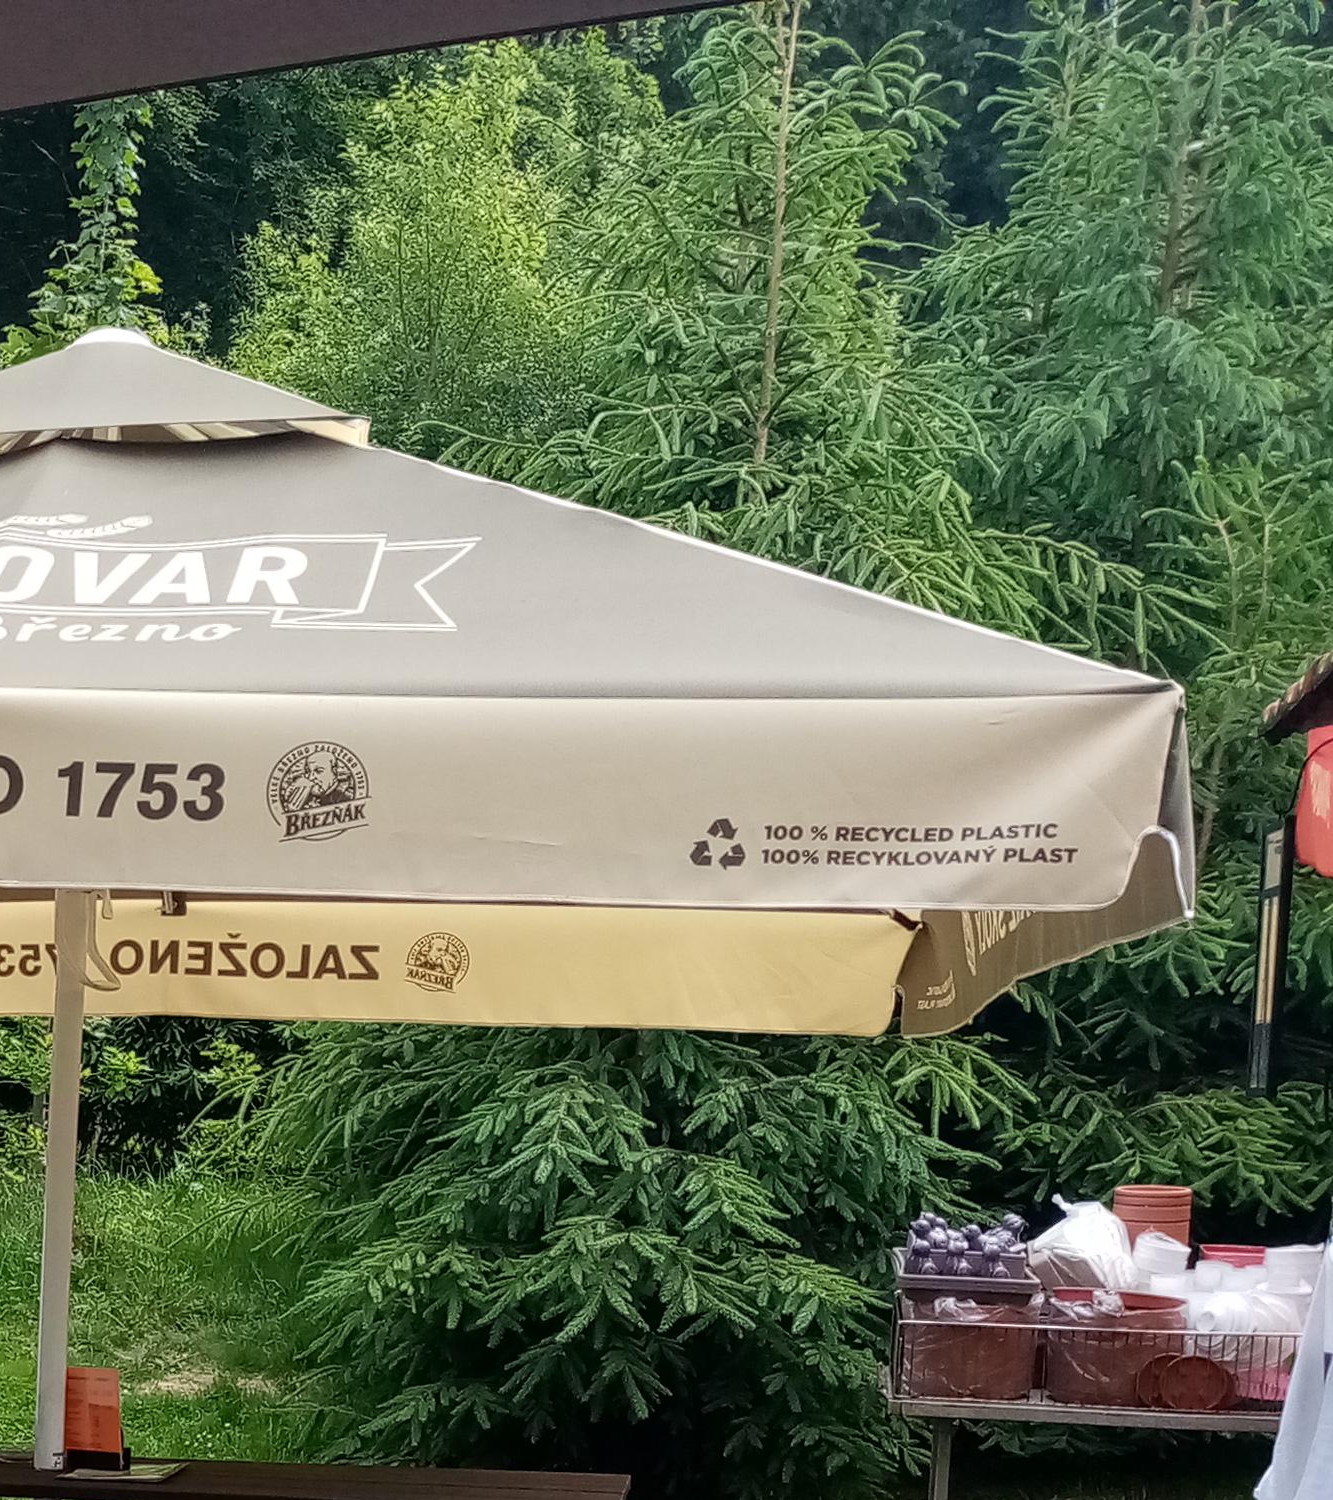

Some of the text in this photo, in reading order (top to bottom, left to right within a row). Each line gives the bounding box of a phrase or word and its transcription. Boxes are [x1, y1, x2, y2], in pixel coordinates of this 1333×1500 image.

[57, 760, 227, 823] 1753
[283, 803, 367, 838] BŘEZŇÁK
[763, 823, 1059, 843] 100 % RECYCLED PLASTIC
[761, 845, 1080, 867] 100% RECYKLOVANÝ PLAST
